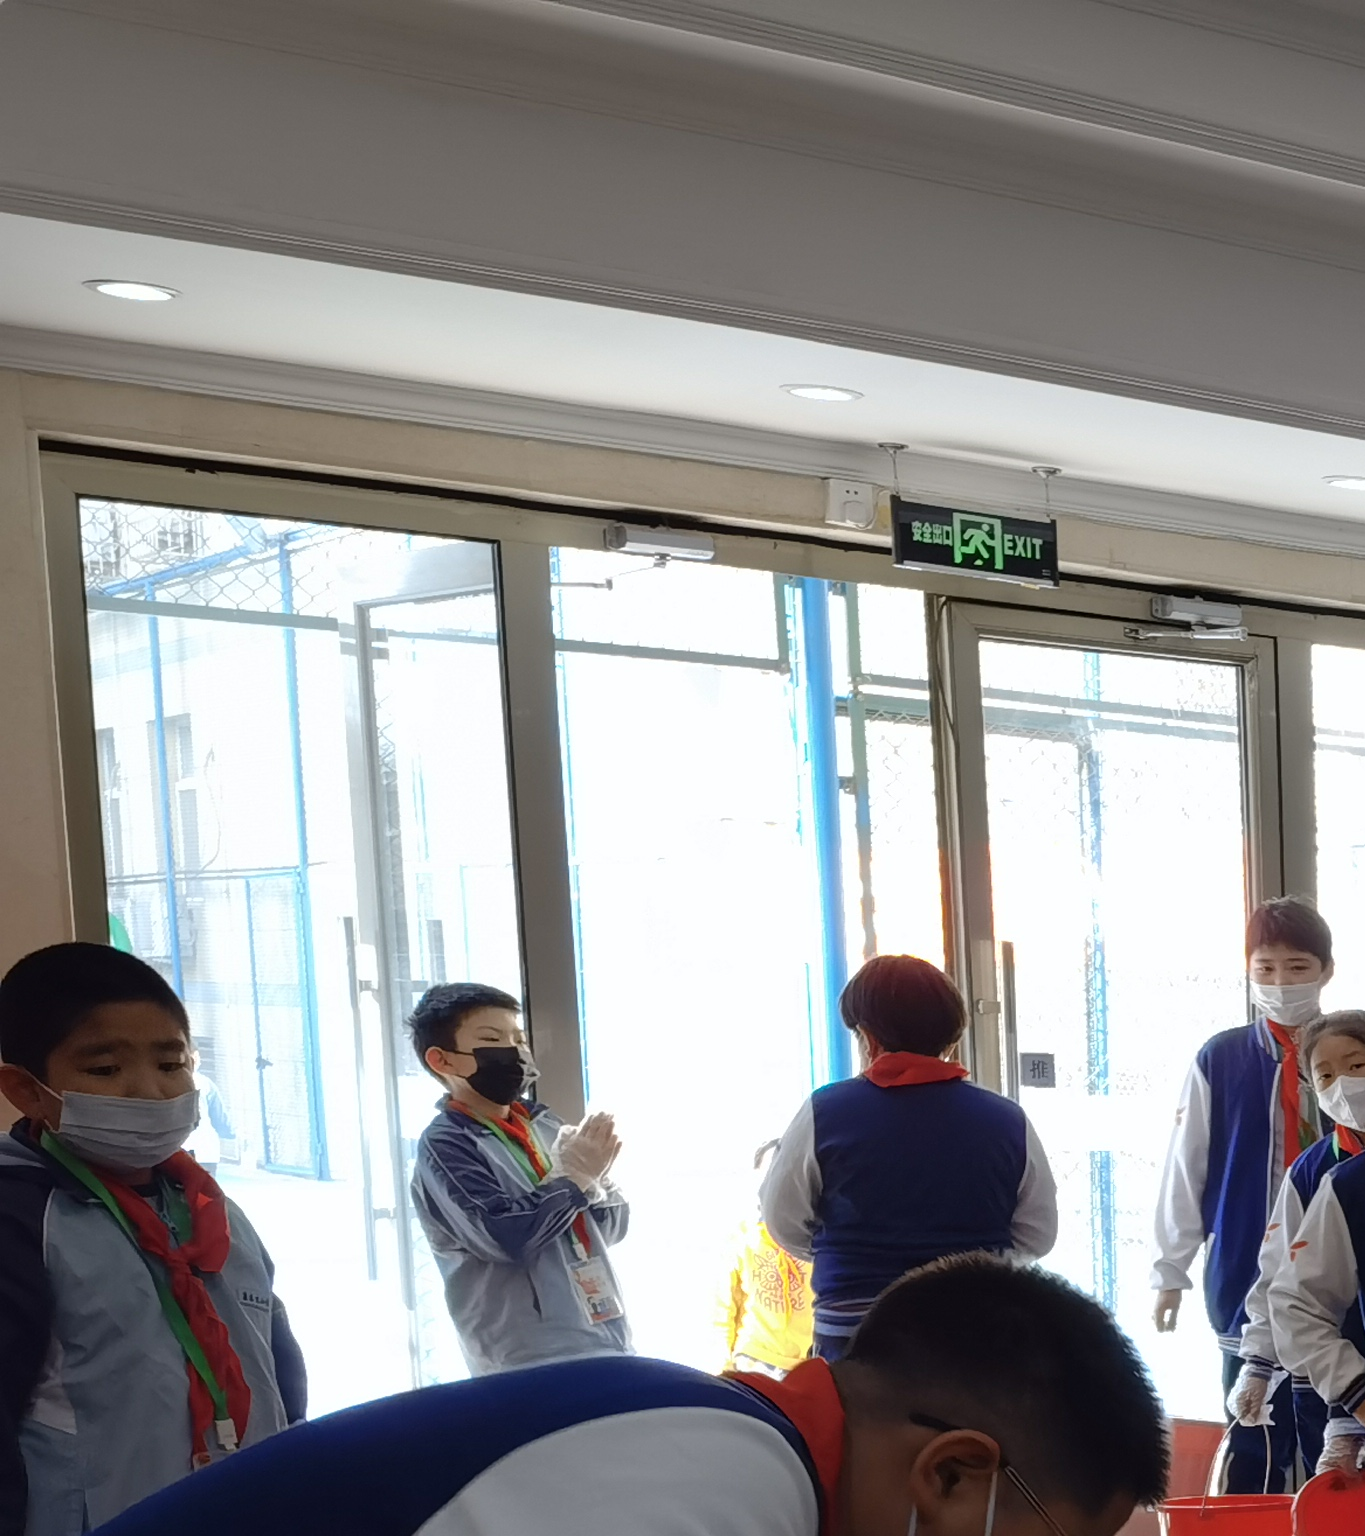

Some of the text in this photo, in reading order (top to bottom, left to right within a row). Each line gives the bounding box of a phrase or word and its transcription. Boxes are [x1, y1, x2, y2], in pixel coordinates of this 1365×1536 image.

[911, 520, 953, 547] 安全出口
[1003, 533, 1044, 560] EXIT
[1029, 1059, 1049, 1079] 推
